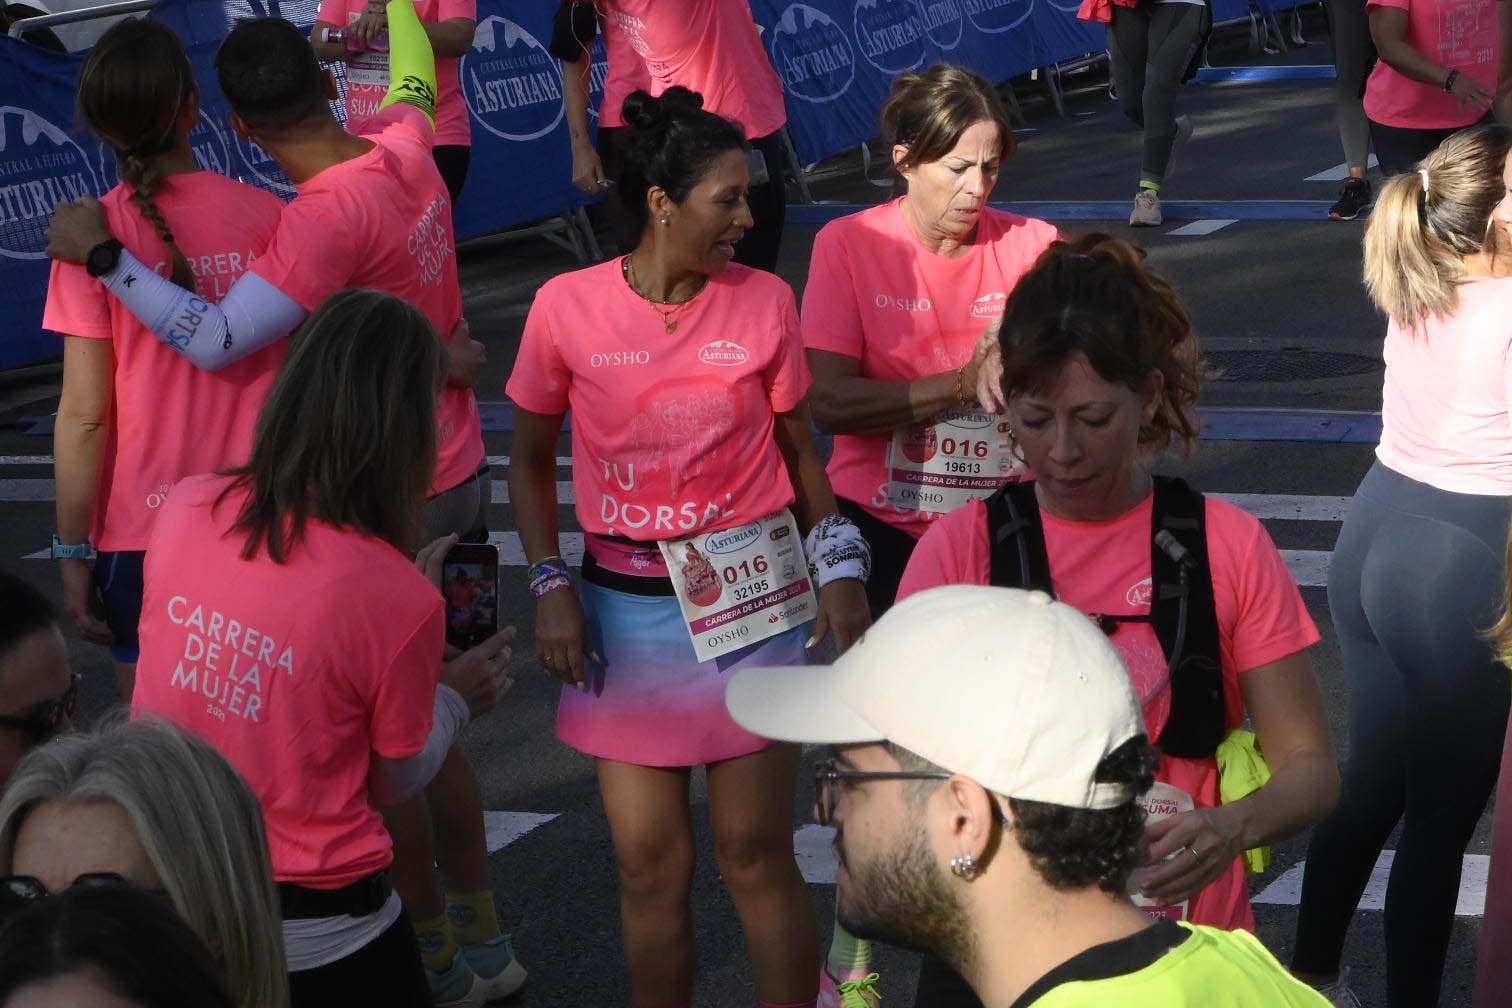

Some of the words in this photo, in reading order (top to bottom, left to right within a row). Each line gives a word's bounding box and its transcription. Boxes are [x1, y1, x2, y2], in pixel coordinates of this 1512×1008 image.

[480, 59, 513, 74] CENTRAL
[471, 66, 561, 115] ASTURIANA
[154, 248, 257, 277] CRRERA
[875, 294, 931, 312] OYSHO
[590, 351, 650, 368] OYSHO
[702, 350, 747, 361] ASTURIANA
[941, 438, 989, 459] 016
[944, 461, 981, 474] 19613
[906, 473, 945, 486] CARRERA
[946, 477, 957, 486] DE
[959, 478, 969, 487] LA
[970, 479, 996, 488] MUJER
[901, 489, 943, 504] OYSHO
[601, 493, 735, 531] DORSAL
[711, 527, 760, 552] ASTURIANA
[723, 554, 769, 585] 016
[733, 579, 769, 601] 32195
[704, 609, 742, 627] CARRERA
[742, 604, 753, 615] DE
[754, 600, 765, 610] LA
[765, 591, 788, 607] MUJER
[167, 595, 294, 675] CARRERA
[707, 625, 749, 649] OYSHO
[185, 633, 220, 672] DE
[228, 649, 262, 687] LA
[170, 661, 263, 722] MUJER
